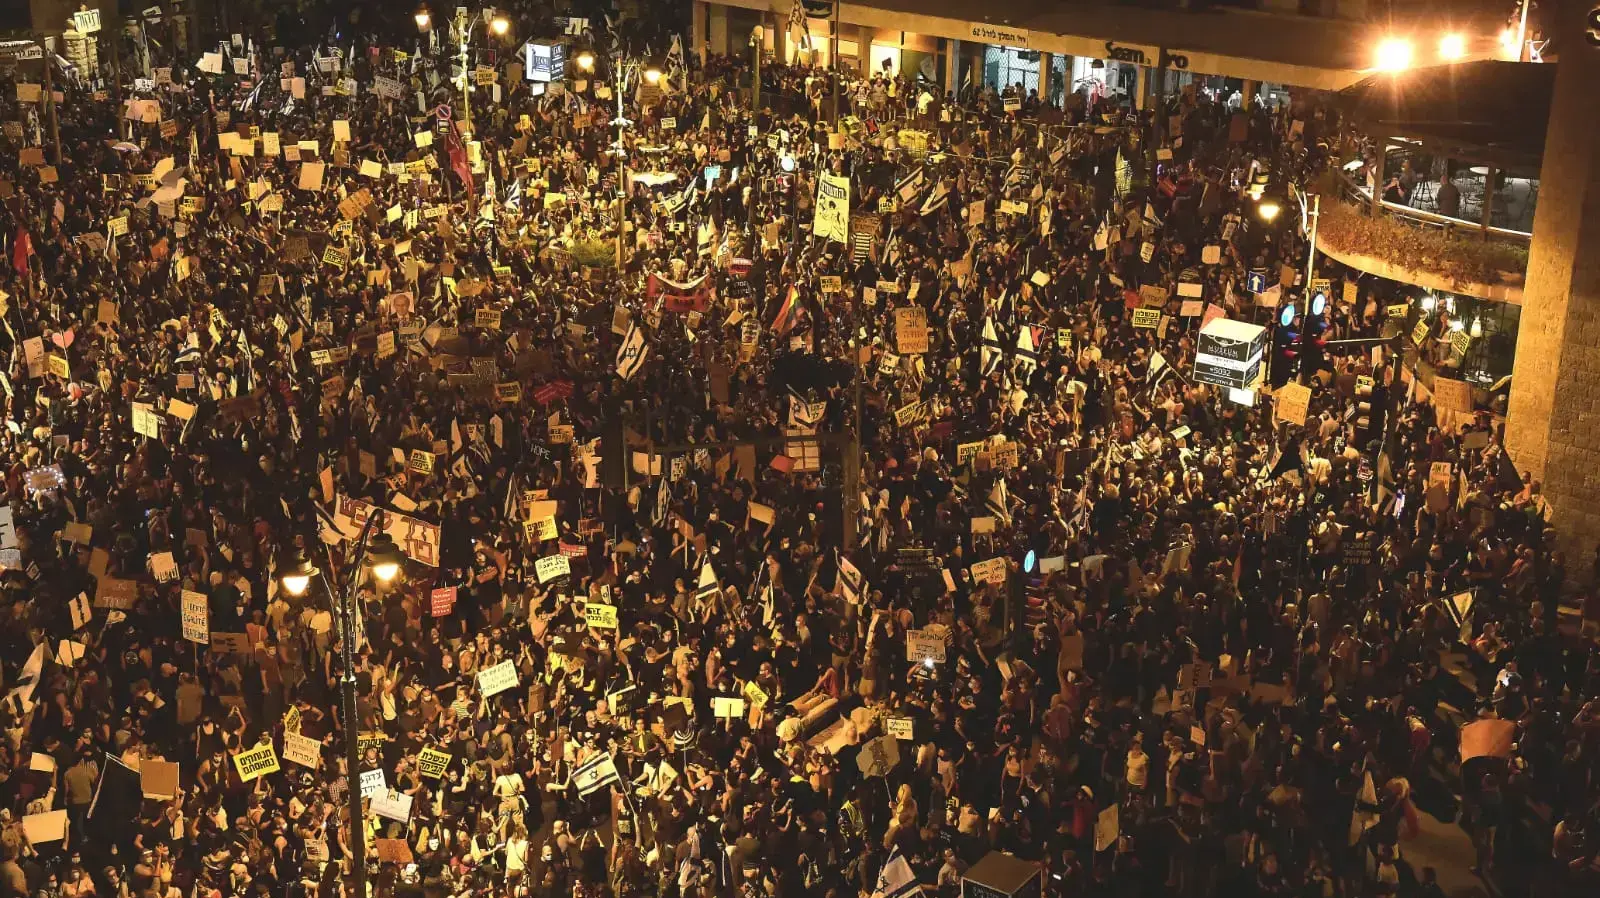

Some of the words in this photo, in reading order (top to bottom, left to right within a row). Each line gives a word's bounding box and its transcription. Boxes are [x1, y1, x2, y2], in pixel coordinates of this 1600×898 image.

[972, 27, 980, 36] 62
[530, 443, 550, 459] HOPE
[239, 749, 272, 766] מנותקים
[421, 751, 449, 764] נכשלת
[243, 758, 275, 775] נמאסתם
[420, 761, 443, 774] הביתה
